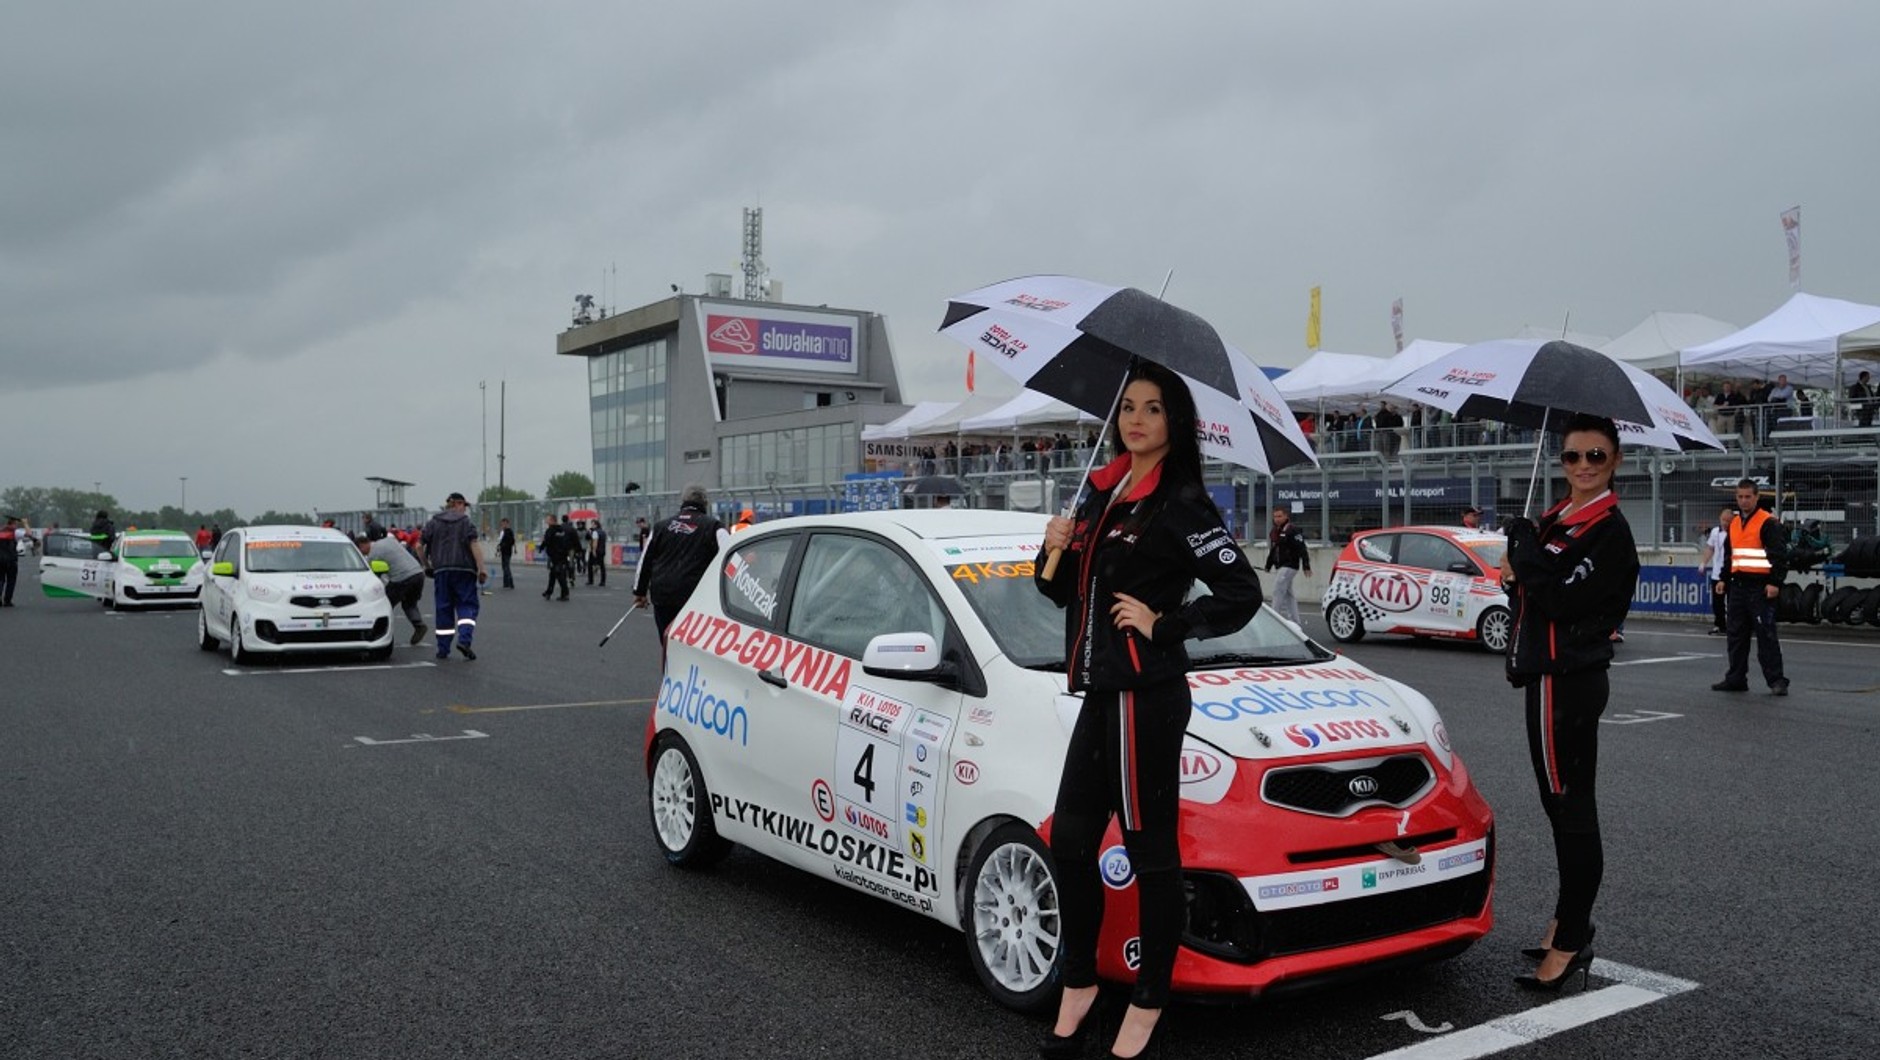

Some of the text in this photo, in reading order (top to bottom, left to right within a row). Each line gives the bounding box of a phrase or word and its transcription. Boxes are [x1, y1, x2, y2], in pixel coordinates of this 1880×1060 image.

[763, 327, 848, 360] slovakiaring
[1441, 374, 1491, 386] RACE
[1375, 487, 1445, 498] RAL Mtorsport
[81, 569, 97, 581] 31
[952, 564, 979, 584] 4
[733, 560, 779, 620] Kostrzak
[1369, 576, 1410, 606] KIA
[1431, 586, 1450, 605] 98
[670, 611, 851, 701] AUTO-GDYNIA
[657, 664, 747, 746] balticon
[856, 691, 902, 717] KIA LOTOS
[1192, 685, 1390, 721] balticon
[850, 707, 893, 734] RACE
[1314, 718, 1390, 742] LOTOS
[854, 743, 875, 803] 4
[957, 765, 974, 780] KIA
[1182, 756, 1210, 775] IA
[1354, 780, 1376, 793] KIA
[817, 789, 830, 813] E
[858, 811, 889, 839] LOTOS
[1109, 859, 1128, 876] PZU
[833, 864, 934, 913] kialotosrace.pl
